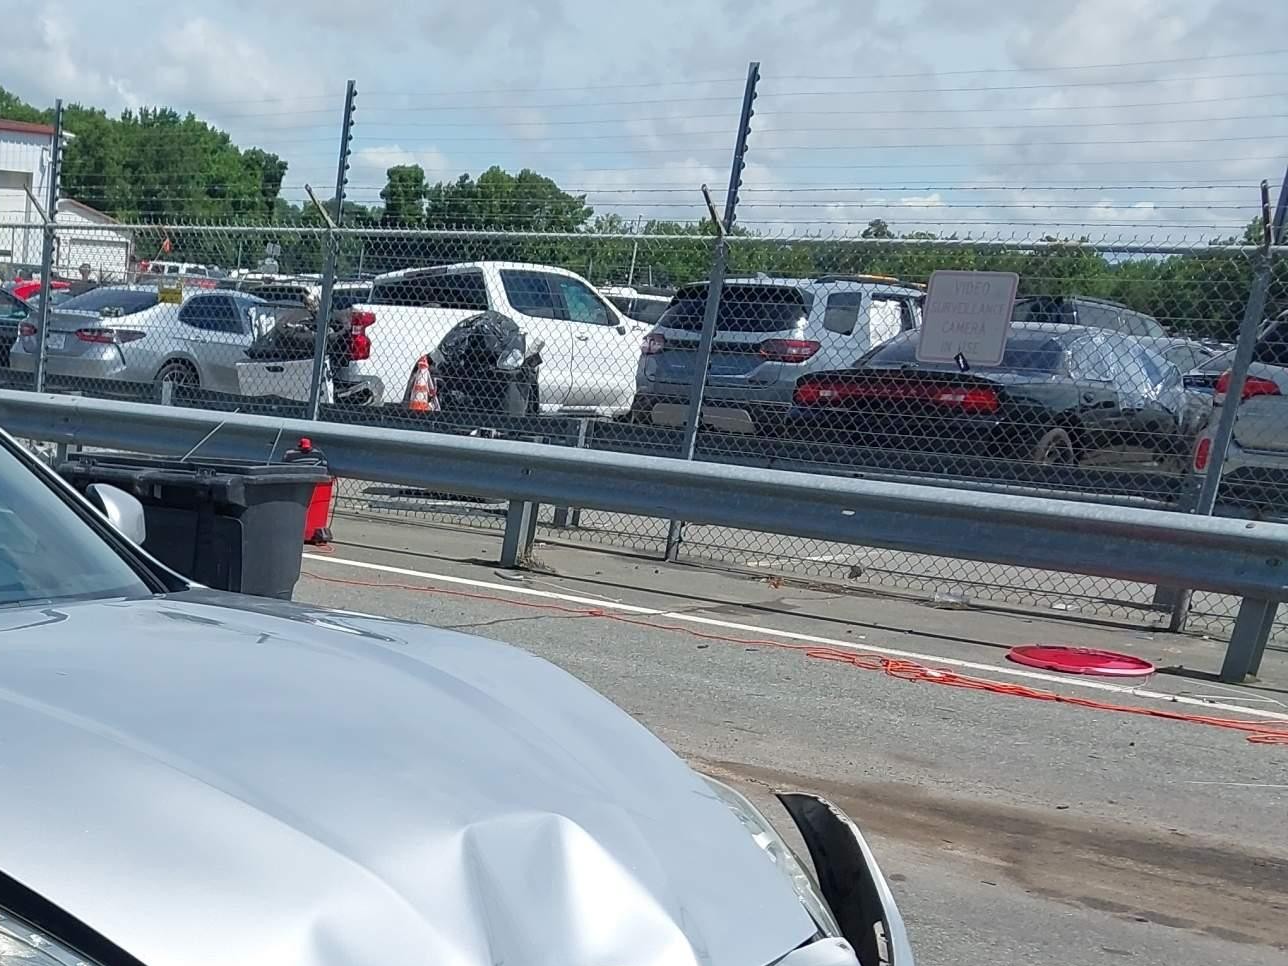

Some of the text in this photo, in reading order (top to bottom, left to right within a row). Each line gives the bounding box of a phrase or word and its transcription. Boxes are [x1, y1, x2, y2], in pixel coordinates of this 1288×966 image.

[953, 280, 991, 297] VIDEO
[931, 301, 1006, 315] SURVEILLANCE
[942, 320, 986, 337] CAMERA
[940, 340, 980, 354] IN USE
